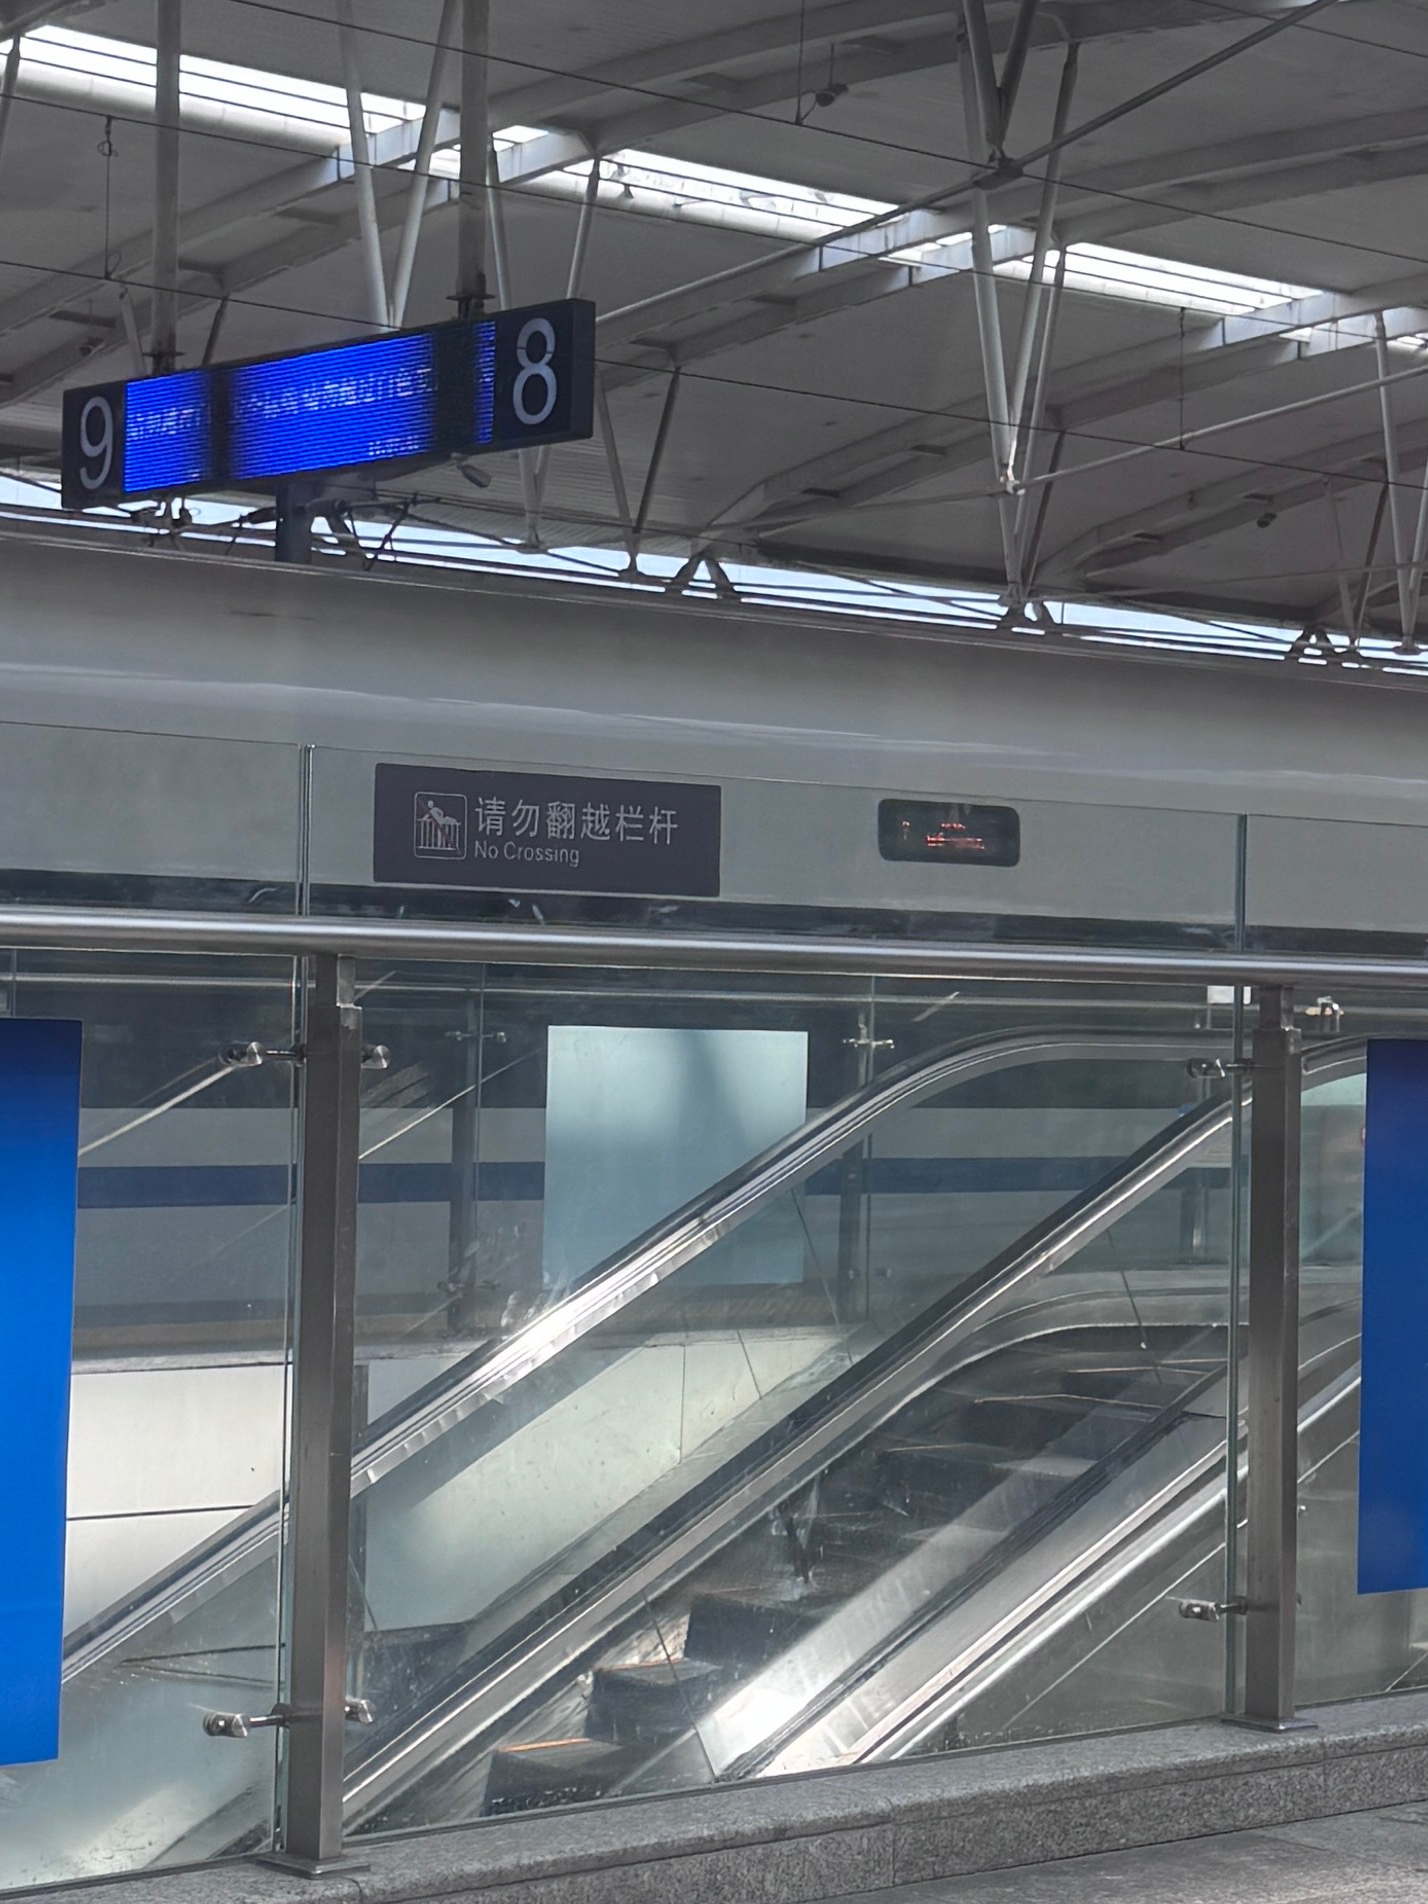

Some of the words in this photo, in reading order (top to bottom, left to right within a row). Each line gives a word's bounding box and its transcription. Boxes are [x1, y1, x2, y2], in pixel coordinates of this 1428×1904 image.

[512, 318, 557, 425] 8
[80, 396, 113, 489] 9
[474, 795, 679, 845] 请勿翻越栏杆
[474, 840, 499, 859] No
[503, 841, 580, 868] Crossing
